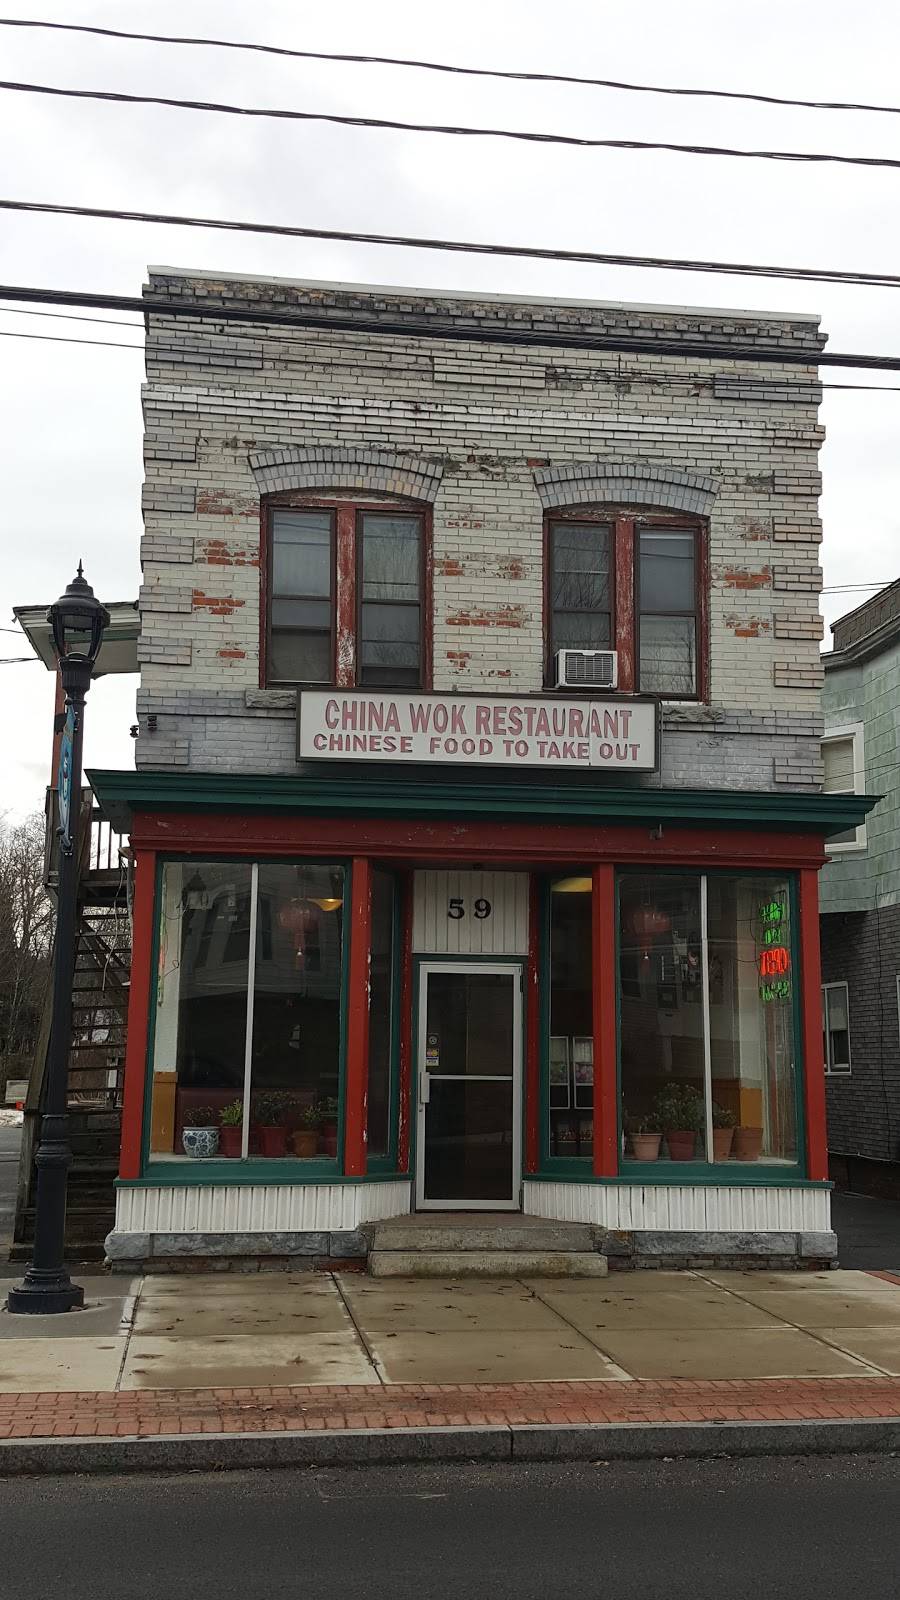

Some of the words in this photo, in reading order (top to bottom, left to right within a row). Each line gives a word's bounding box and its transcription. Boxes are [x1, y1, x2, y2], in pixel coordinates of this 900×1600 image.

[325, 700, 401, 733] CHINA
[410, 702, 467, 735] WOK
[475, 705, 633, 739] RESTAURANT
[313, 733, 413, 753] CHINESE
[429, 737, 493, 756] FOOD
[502, 740, 529, 757] TO
[537, 741, 590, 759] TAKE
[599, 743, 641, 761] OUT
[448, 898, 492, 920] 59
